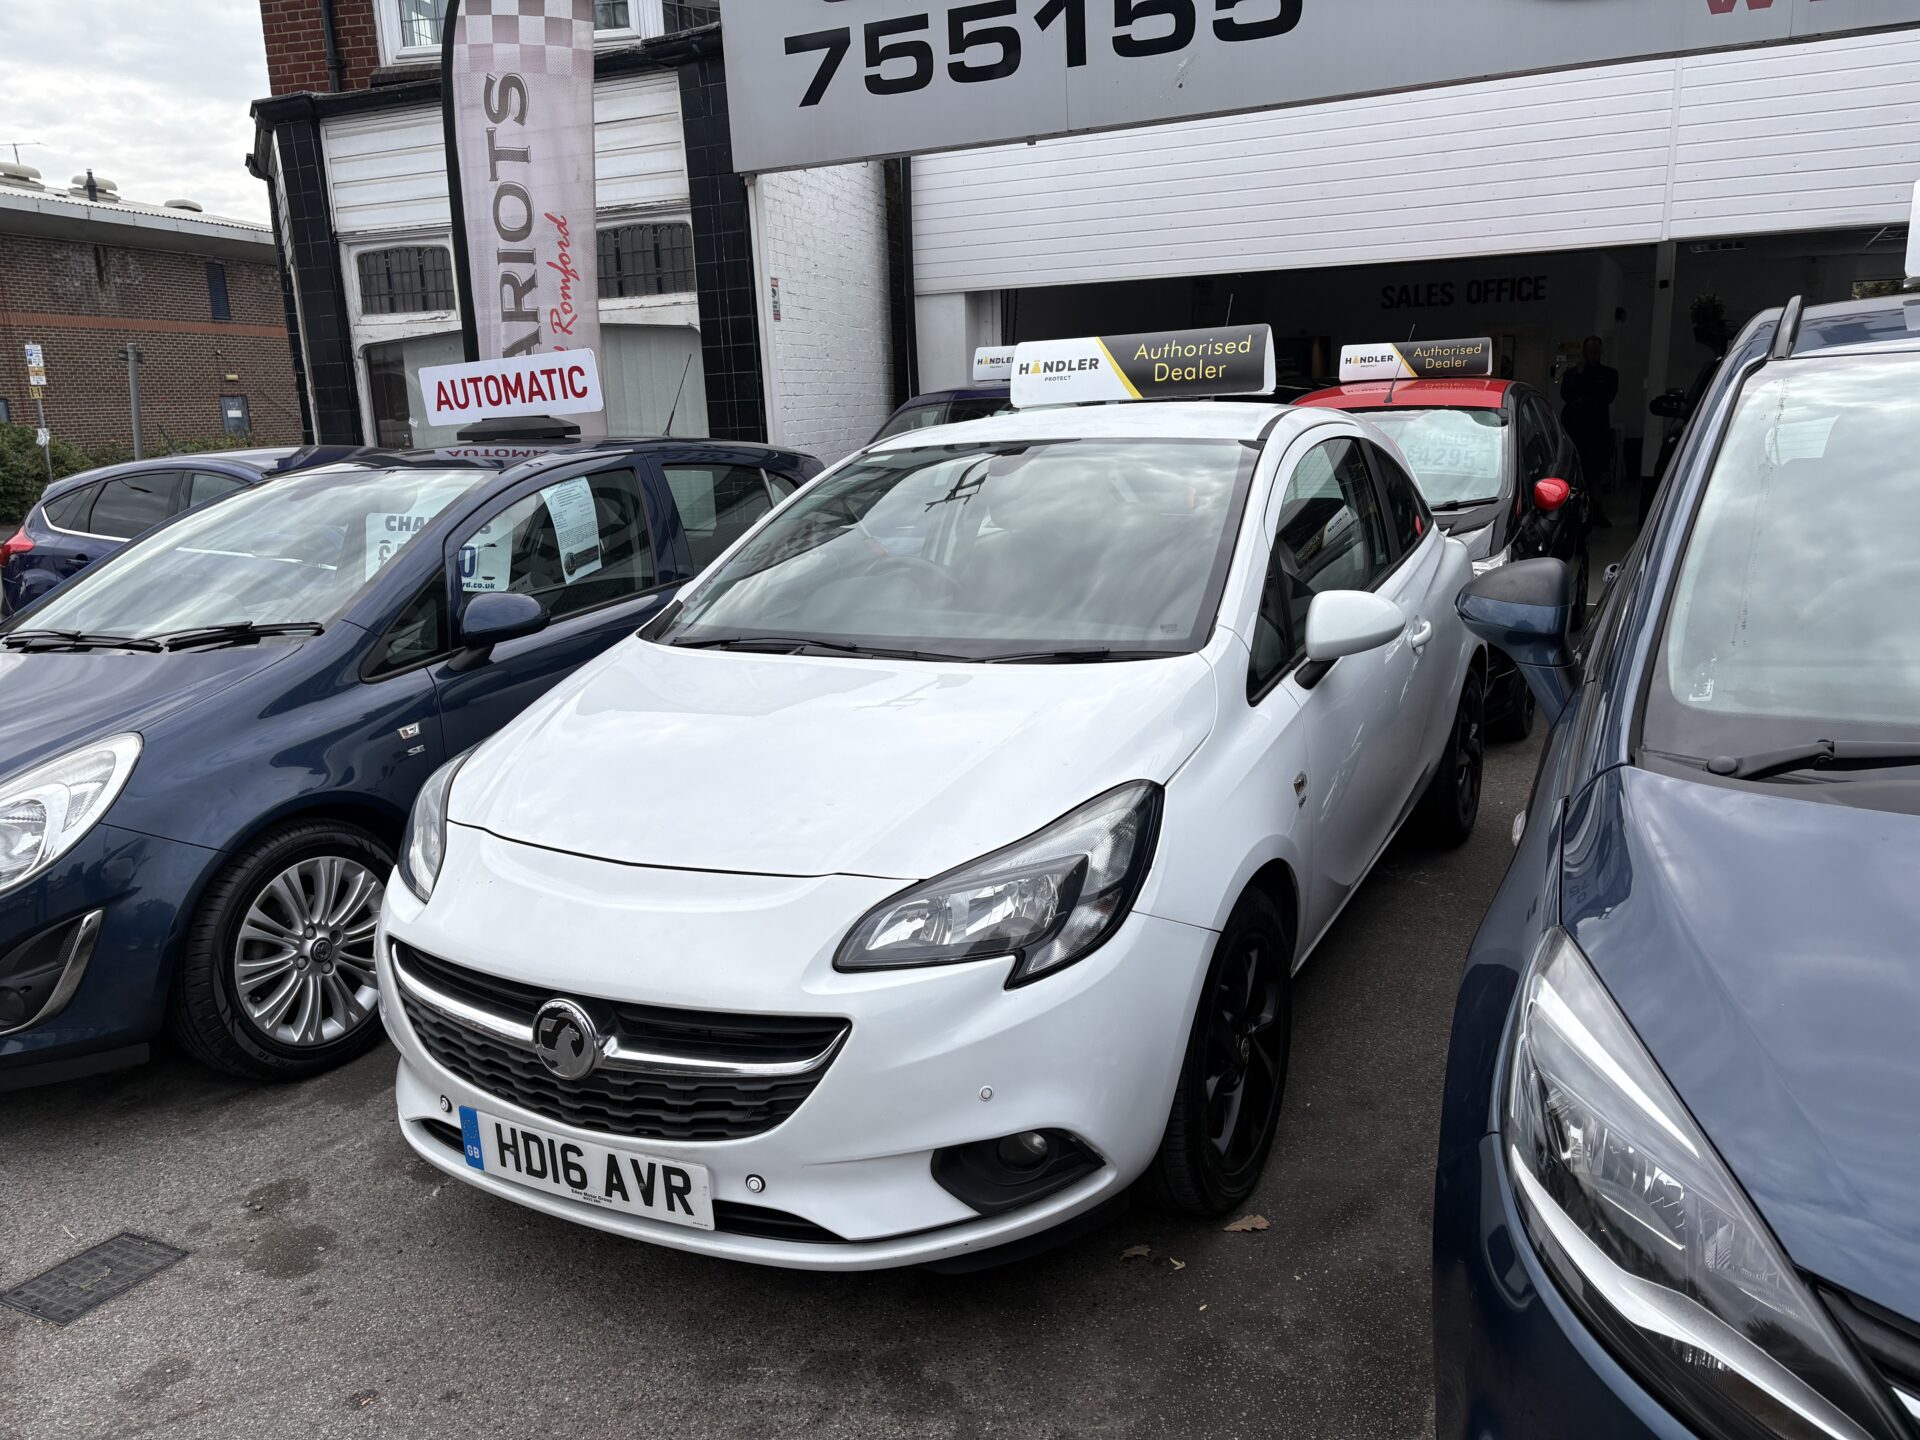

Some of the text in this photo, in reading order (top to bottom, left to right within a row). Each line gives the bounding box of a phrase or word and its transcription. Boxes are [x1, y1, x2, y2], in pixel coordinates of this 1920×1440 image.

[544, 212, 578, 335] Romford
[1381, 276, 1547, 309] SALES OFFICE
[1133, 334, 1253, 361] Authorised
[1413, 343, 1483, 358] Authorised
[1154, 360, 1227, 383] Dealer
[1425, 355, 1468, 369] Dealer
[436, 365, 588, 412] AUTOMATIC
[466, 1144, 480, 1159] GB
[495, 1122, 695, 1216] HD16 AVR
